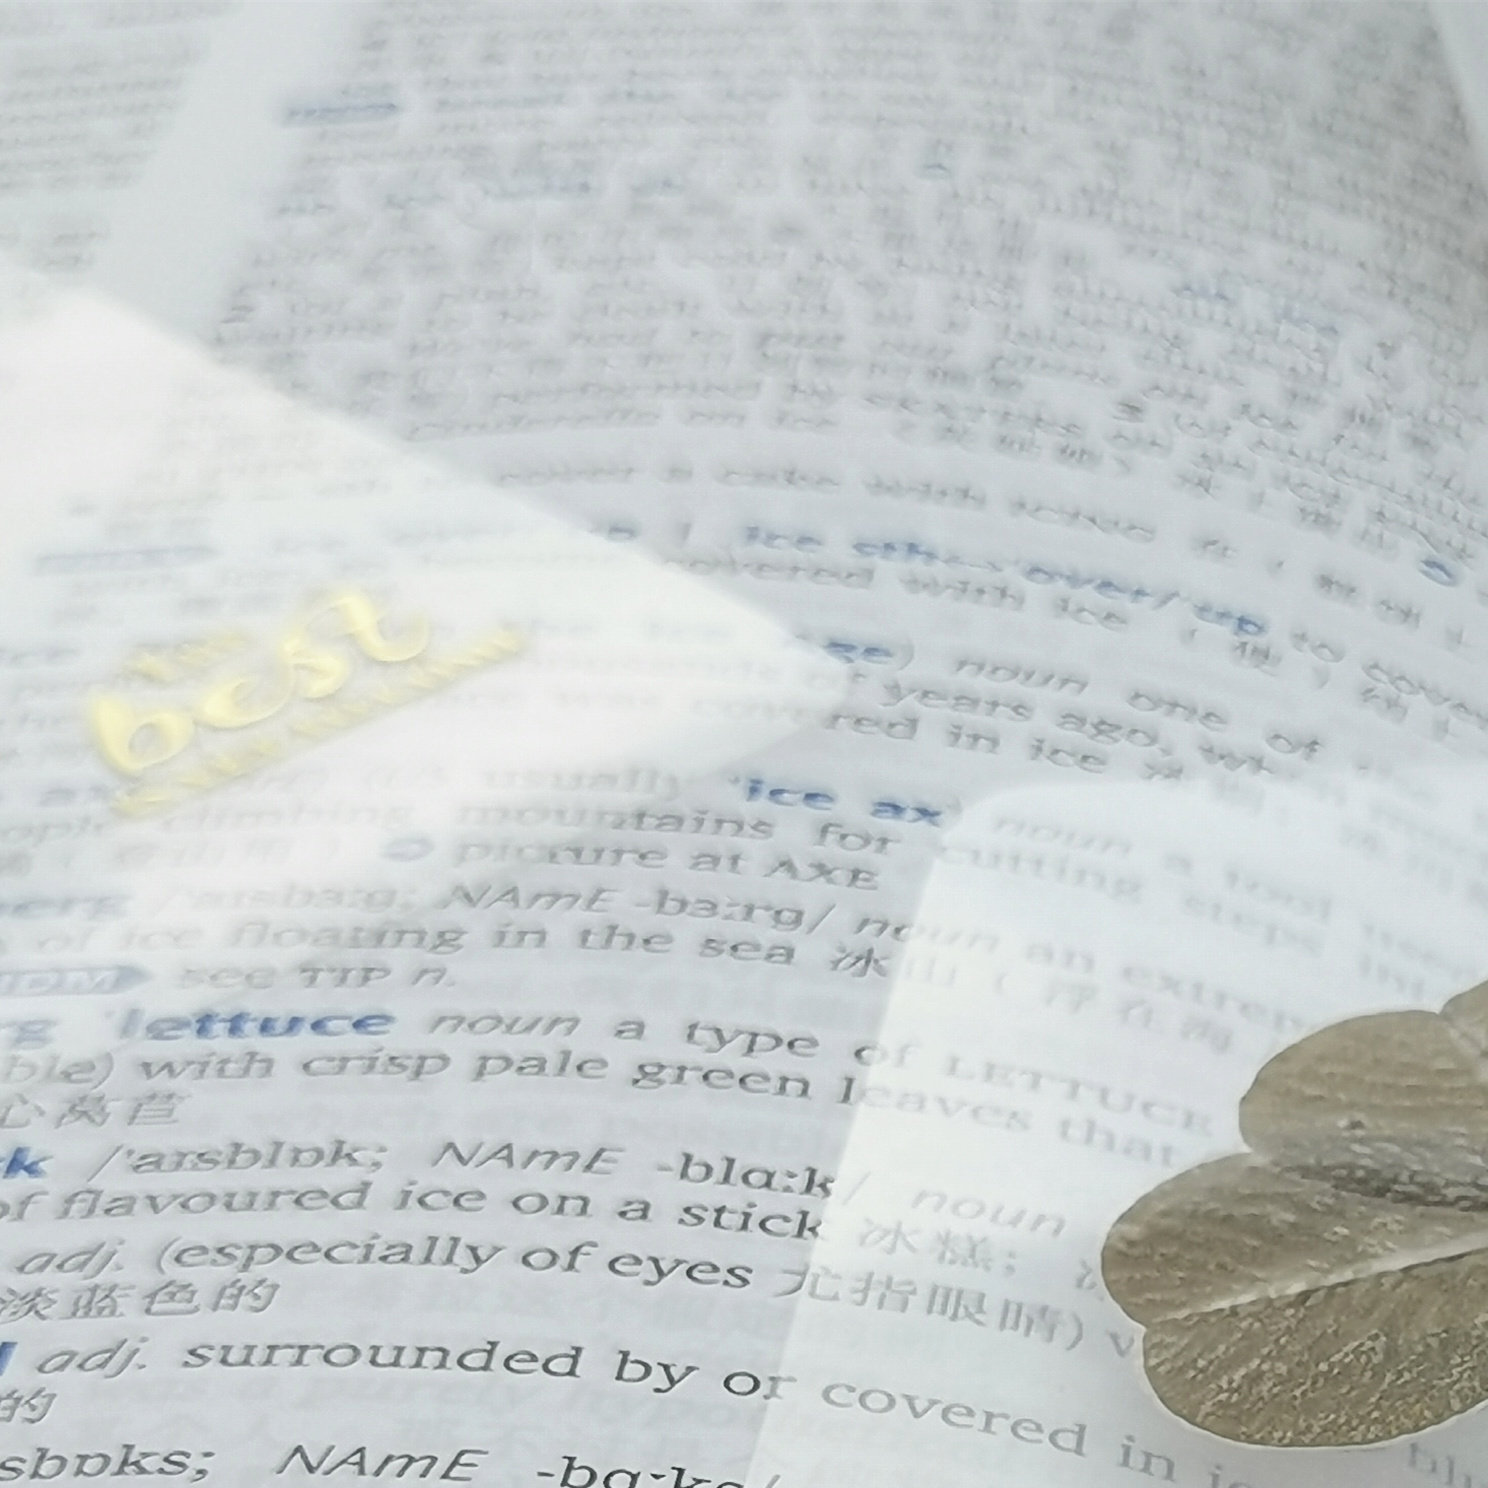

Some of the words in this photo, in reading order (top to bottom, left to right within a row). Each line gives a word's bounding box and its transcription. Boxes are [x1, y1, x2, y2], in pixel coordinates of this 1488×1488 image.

[956, 658, 1089, 696] noun
[1129, 690, 1228, 733] one
[458, 803, 774, 841] mountains
[811, 821, 903, 857] for
[688, 850, 747, 875] at
[762, 856, 880, 892] AXE
[492, 922, 548, 950] in
[578, 923, 675, 953] the
[698, 936, 798, 966] sea
[426, 1012, 581, 1036] noun
[614, 1019, 646, 1040] a
[685, 1020, 821, 1058] type
[139, 1052, 275, 1082] with
[302, 1048, 452, 1084] crisp
[471, 1050, 610, 1082] pale
[630, 1061, 812, 1100] green
[430, 1141, 625, 1175] NAmE
[56, 1180, 373, 1220] flavoured
[394, 1180, 486, 1213] ice
[511, 1191, 593, 1216] on
[617, 1198, 652, 1222] a
[678, 1201, 824, 1240] stick
[16, 1239, 125, 1280] adj.
[158, 1233, 504, 1276] (especially
[520, 1240, 600, 1274] of
[607, 1249, 757, 1291] eyes
[37, 1337, 149, 1378] adj.
[182, 1339, 583, 1380] surrounded
[614, 1350, 699, 1395] by
[722, 1366, 797, 1400] or
[821, 1381, 1087, 1456] covered
[1118, 1434, 1177, 1482] in
[275, 1443, 491, 1485] NAmE
